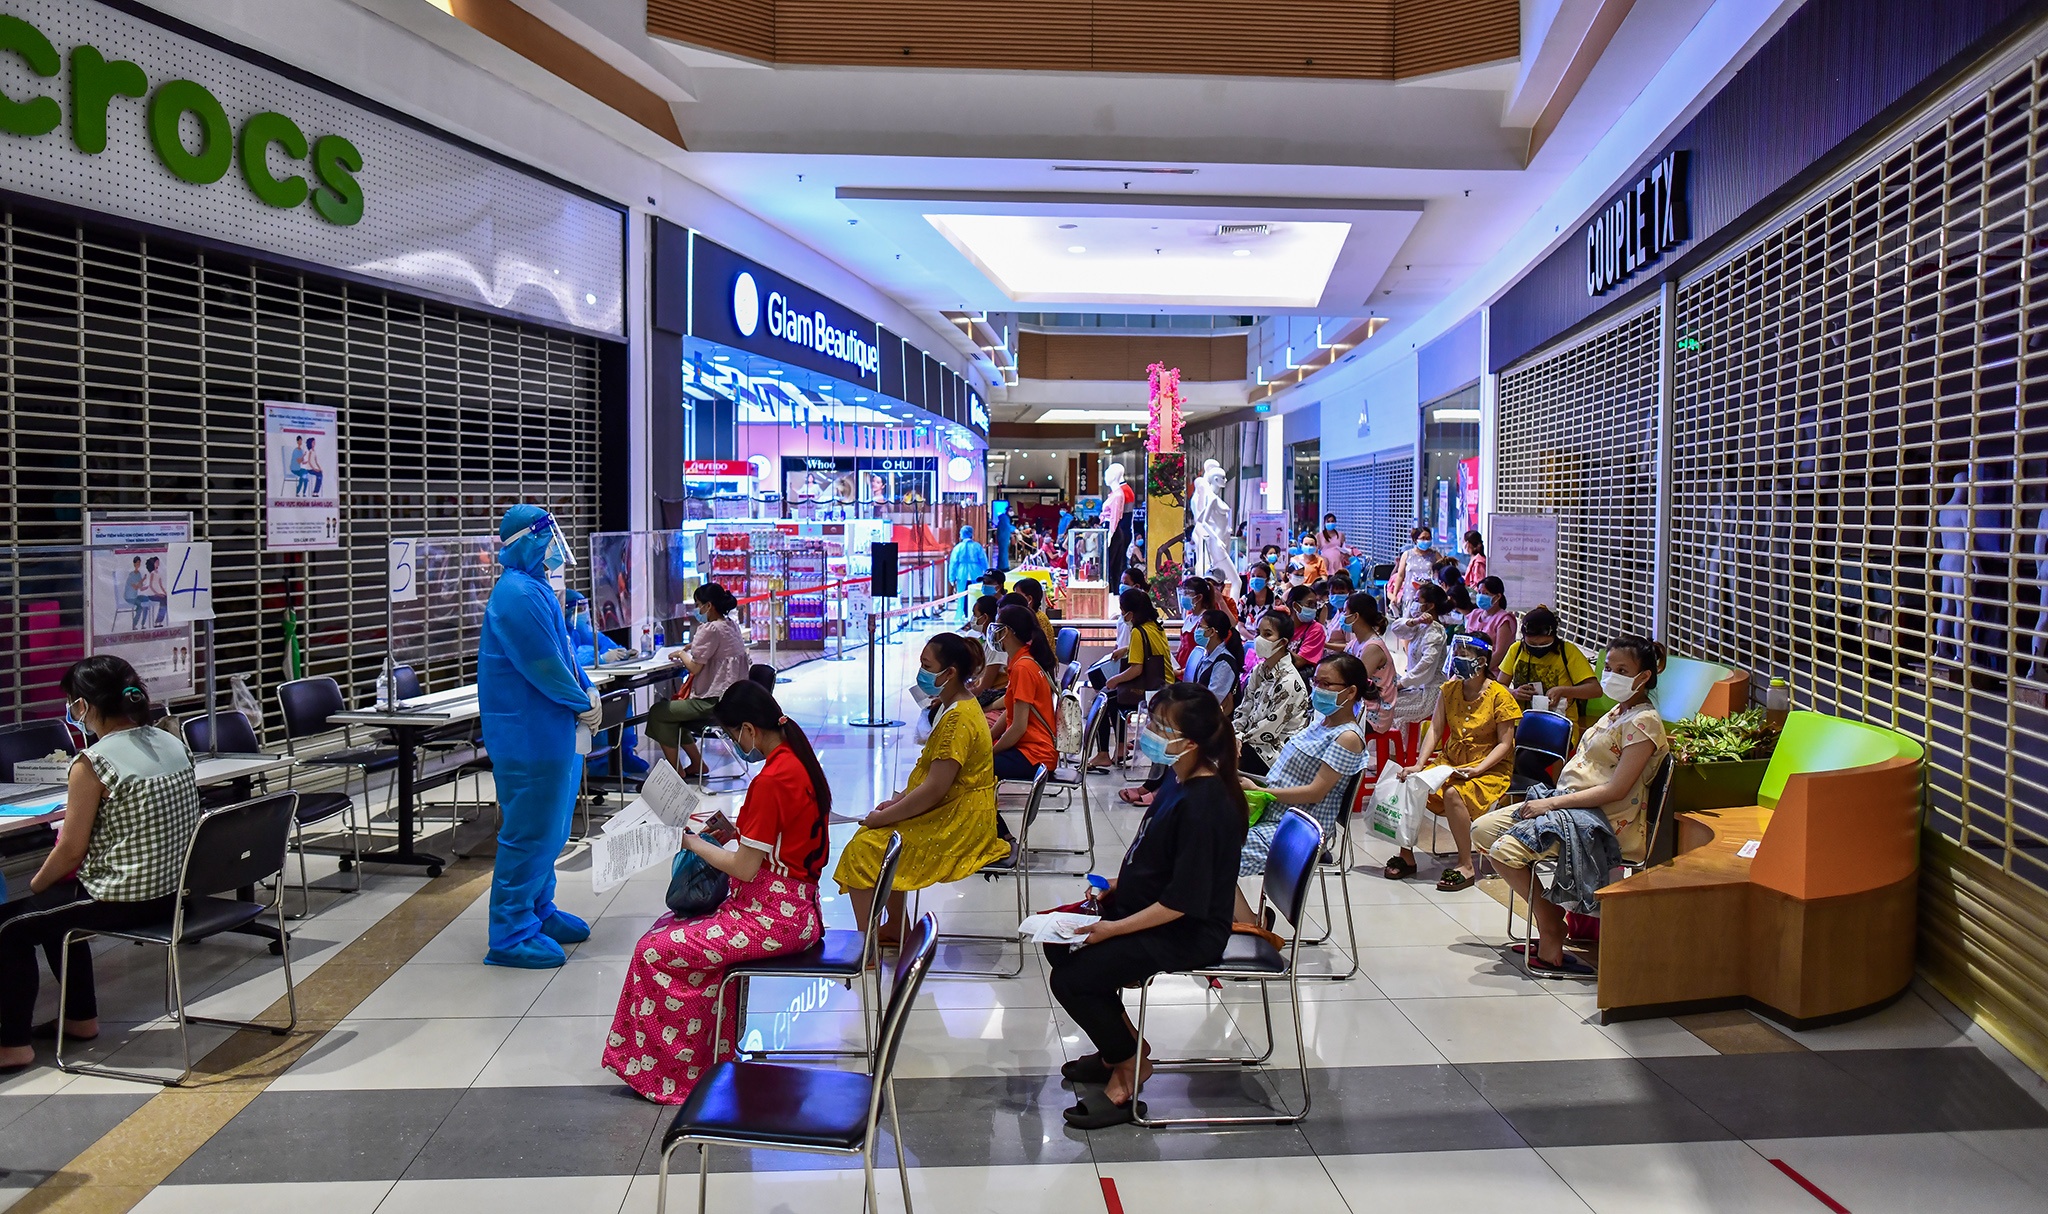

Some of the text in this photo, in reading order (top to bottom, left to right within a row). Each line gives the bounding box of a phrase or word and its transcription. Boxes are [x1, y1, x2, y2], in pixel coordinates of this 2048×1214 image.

[0, 14, 364, 226] crocs
[1587, 151, 1675, 297] COUPLE TX
[768, 291, 877, 378] Glam Beautique
[894, 461, 913, 470] HUI
[171, 546, 208, 608] 4
[392, 541, 412, 593] 3
